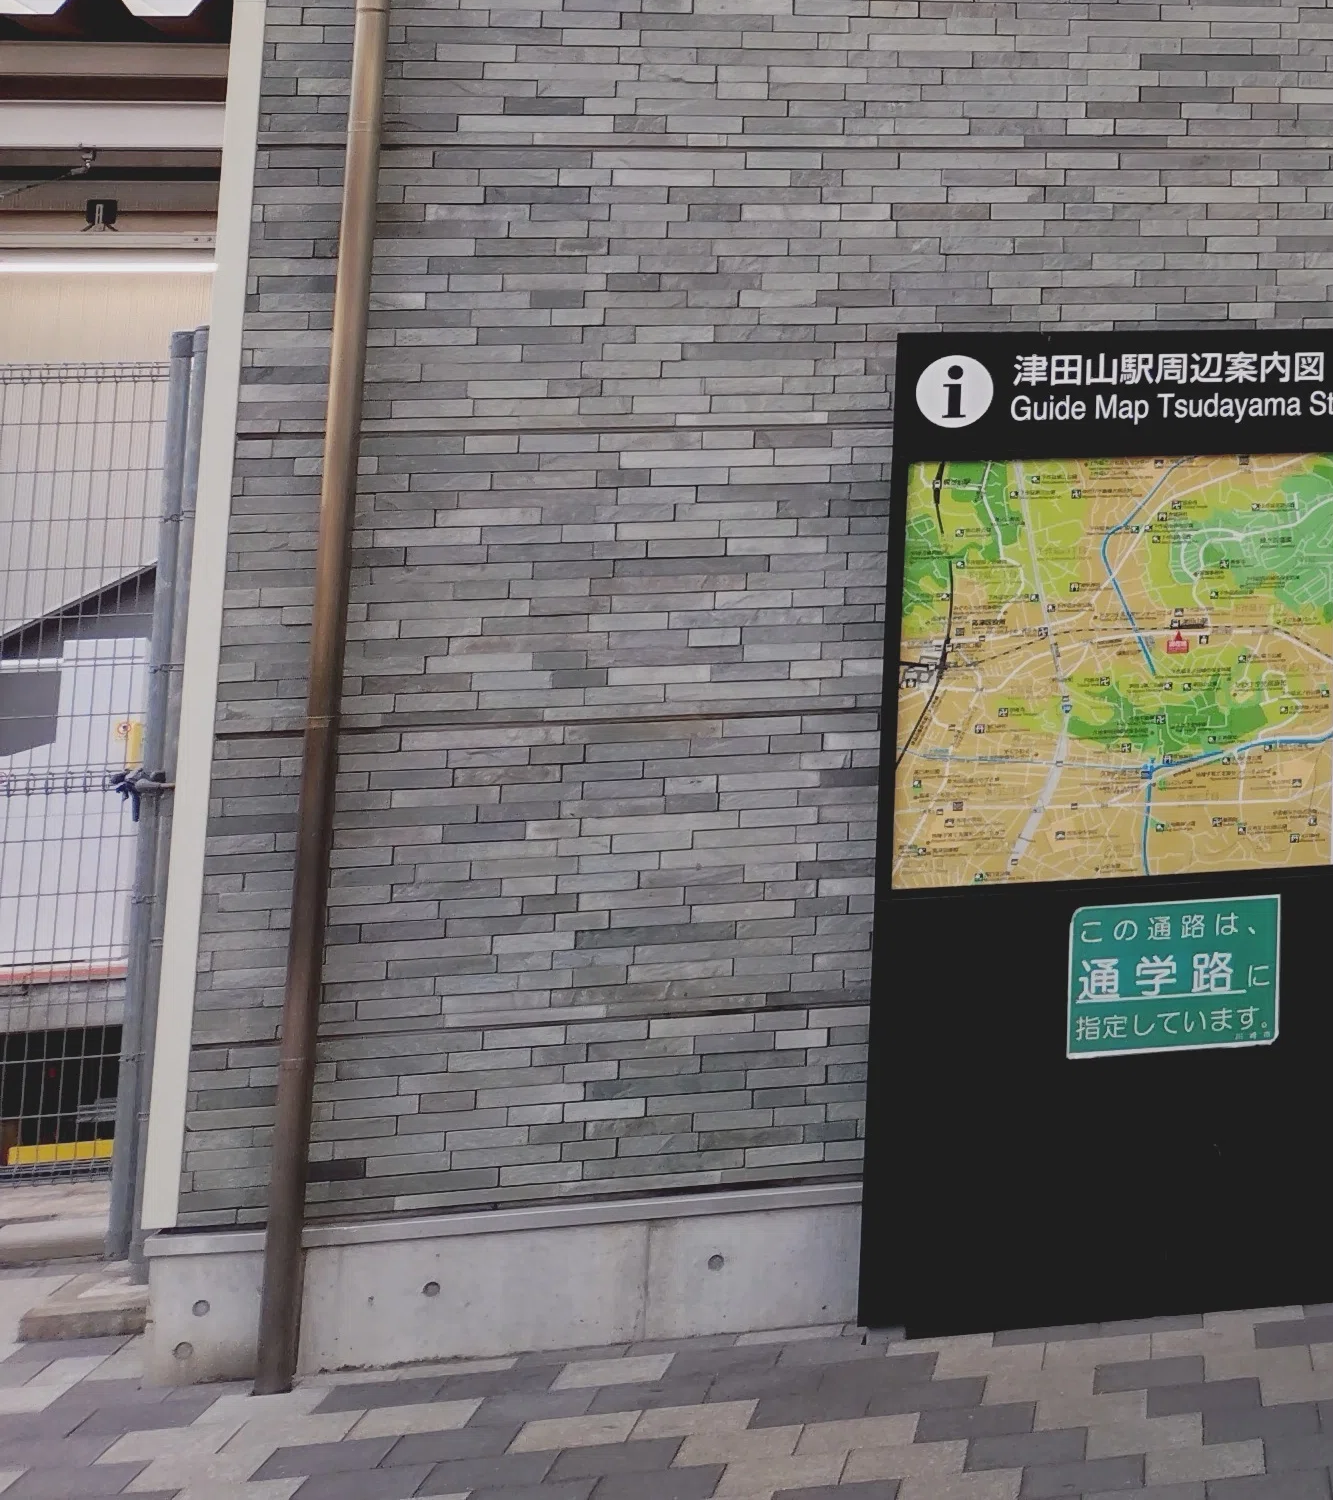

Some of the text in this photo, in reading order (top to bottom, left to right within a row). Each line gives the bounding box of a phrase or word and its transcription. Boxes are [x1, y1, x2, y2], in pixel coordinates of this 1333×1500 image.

[1012, 351, 1326, 387] 津田山駅周辺案内図
[1010, 395, 1086, 422] Guide
[1095, 394, 1150, 424] Map
[1156, 393, 1302, 425] Tsudayama
[1081, 912, 1256, 943] この通路は、
[1078, 952, 1271, 1001] 通学路に
[1075, 1006, 1268, 1041] 指定しています。
